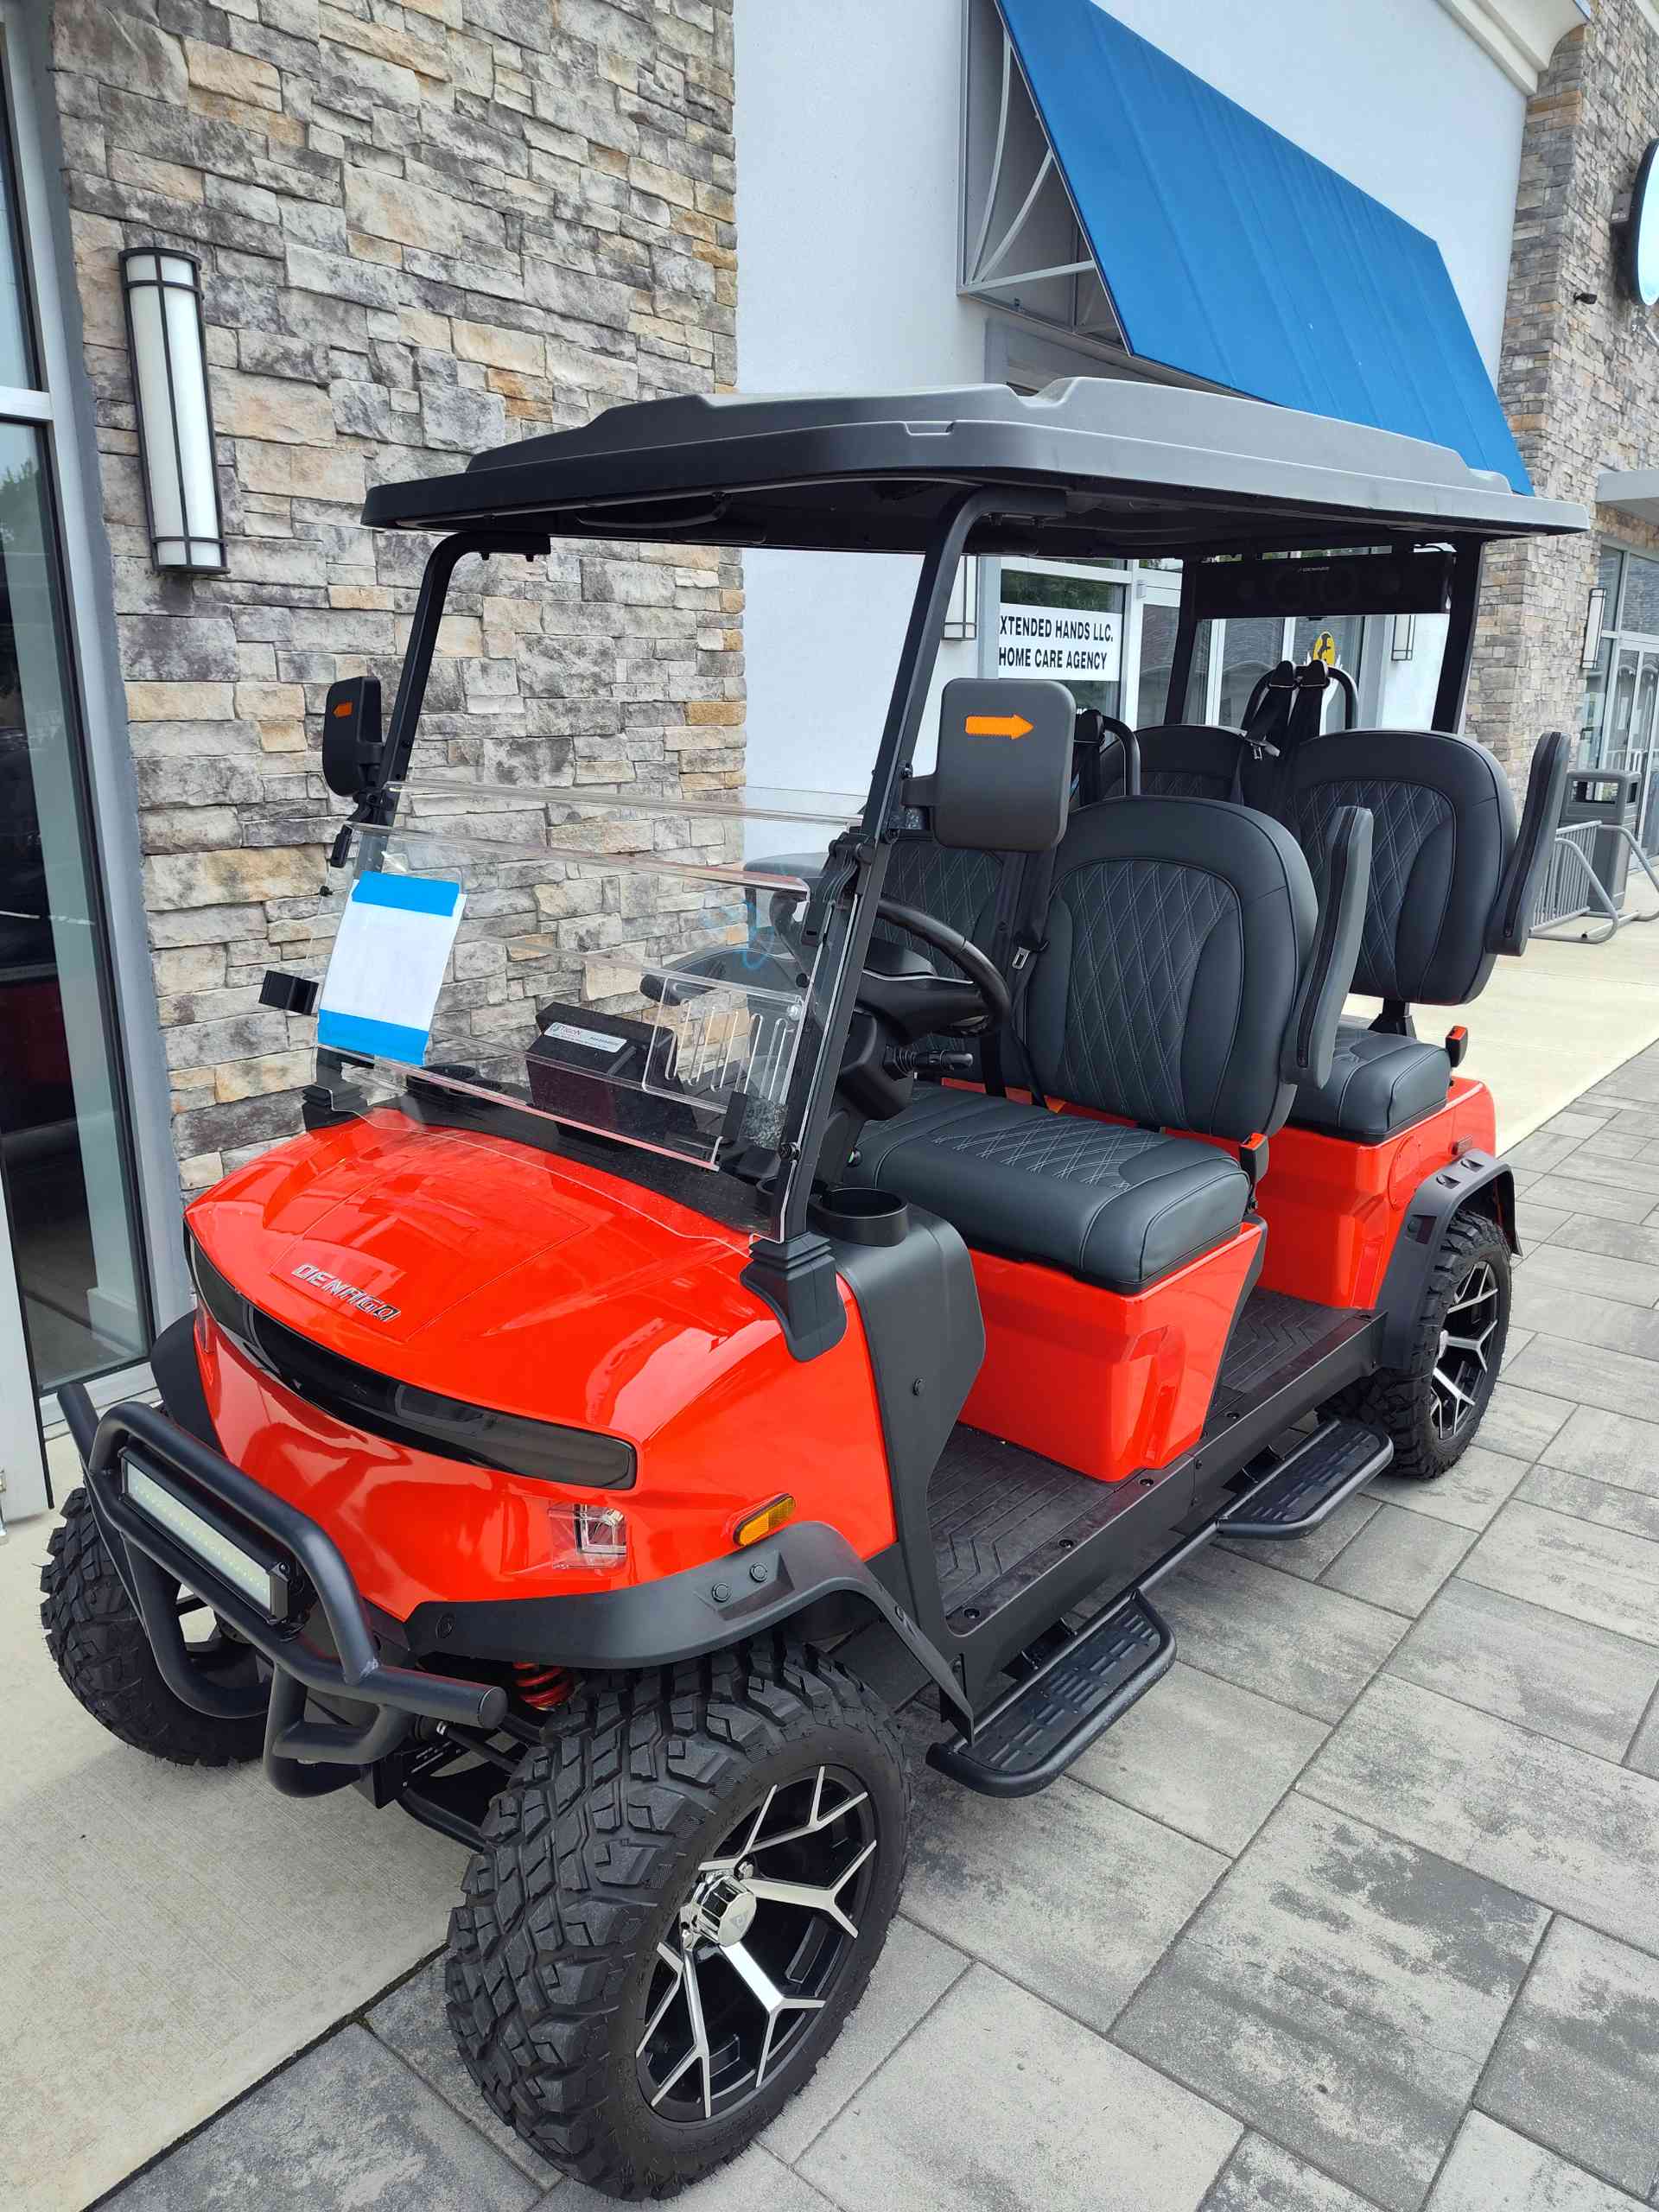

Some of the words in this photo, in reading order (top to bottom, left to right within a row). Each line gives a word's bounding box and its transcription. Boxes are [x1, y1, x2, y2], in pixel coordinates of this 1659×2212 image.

[1055, 620, 1090, 640] HANDS
[1093, 623, 1114, 642] LLC.
[999, 647, 1032, 667] HOME
[1034, 649, 1064, 668] CARE
[1065, 651, 1108, 670] AGENCY
[291, 1263, 401, 1322] DENAGO
